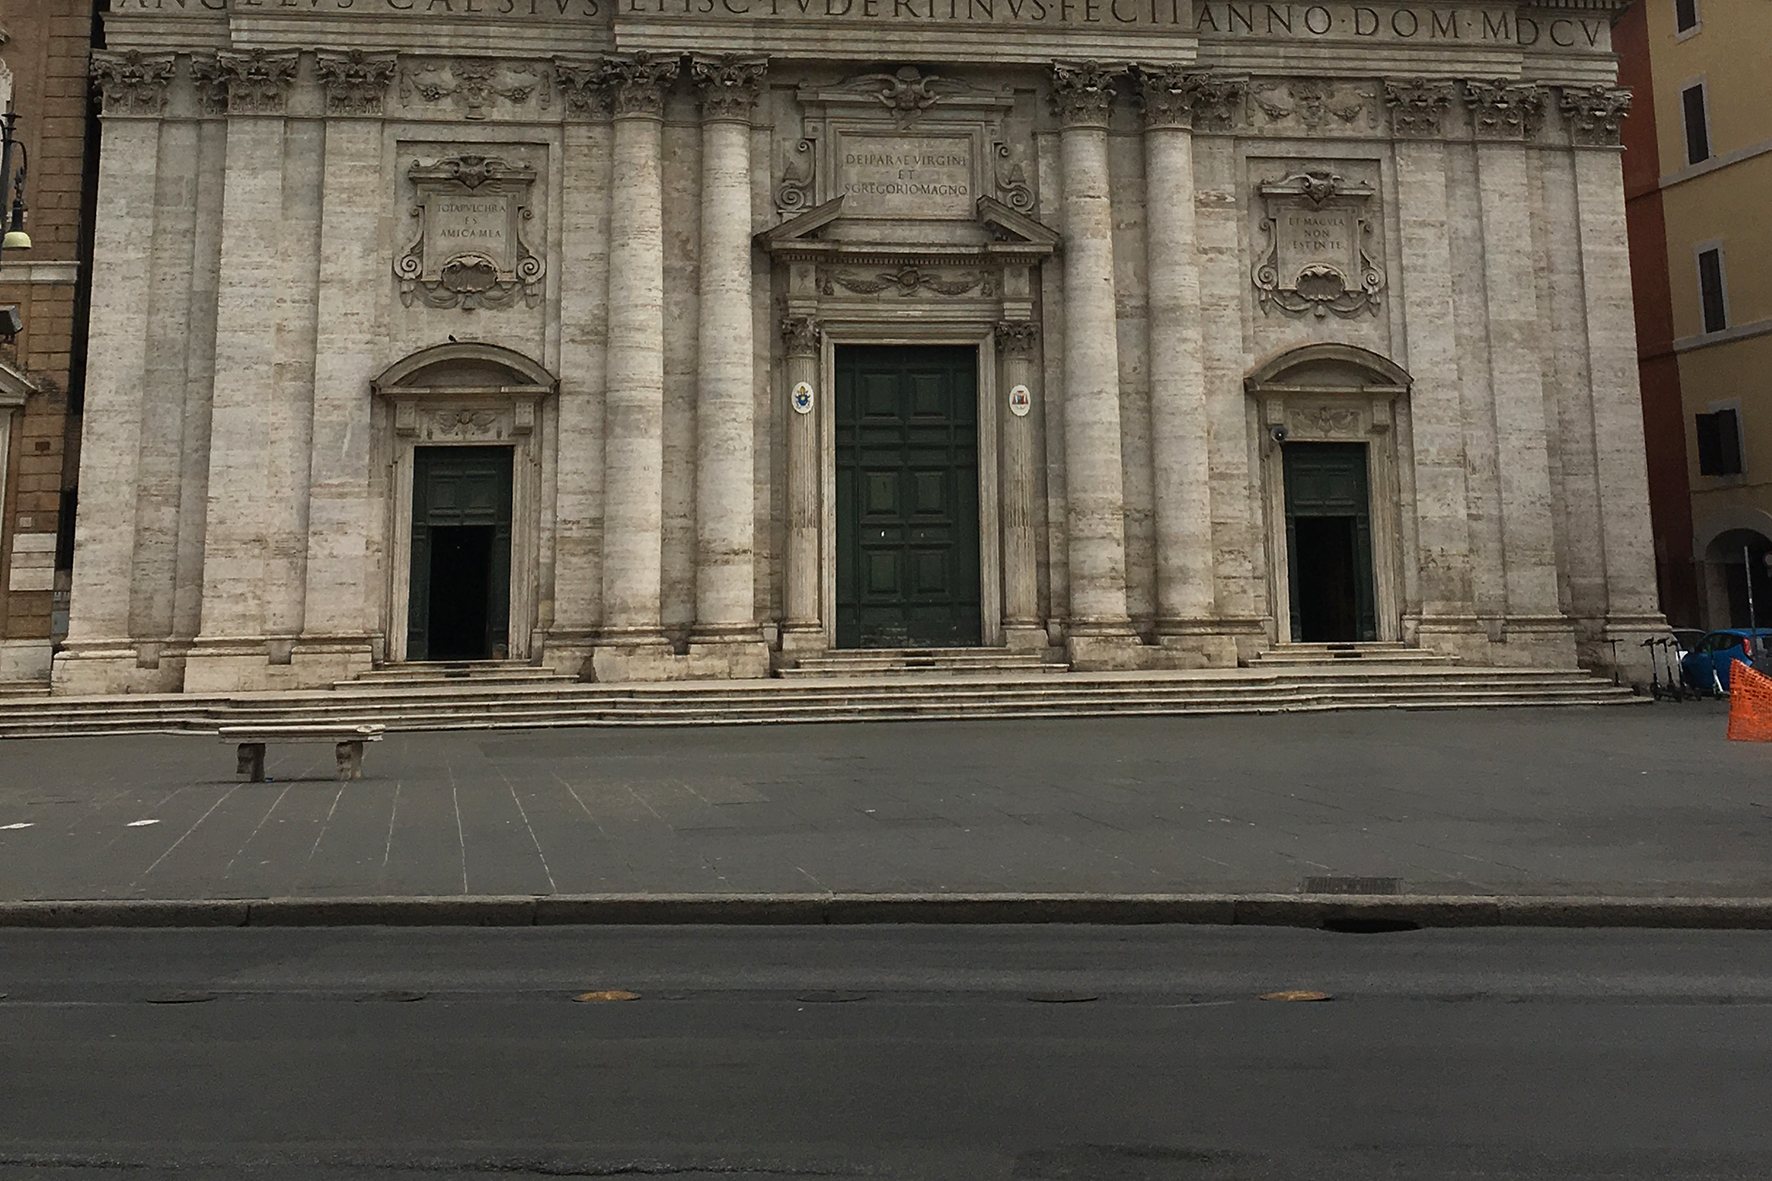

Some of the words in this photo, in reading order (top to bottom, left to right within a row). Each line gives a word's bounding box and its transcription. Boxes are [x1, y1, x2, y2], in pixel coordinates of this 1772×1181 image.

[1196, 2, 1333, 35] ANNO
[1352, 6, 1461, 40] DOM
[1481, 10, 1602, 47] MDCV
[913, 154, 967, 166] VIRGINI
[898, 169, 915, 180] ET
